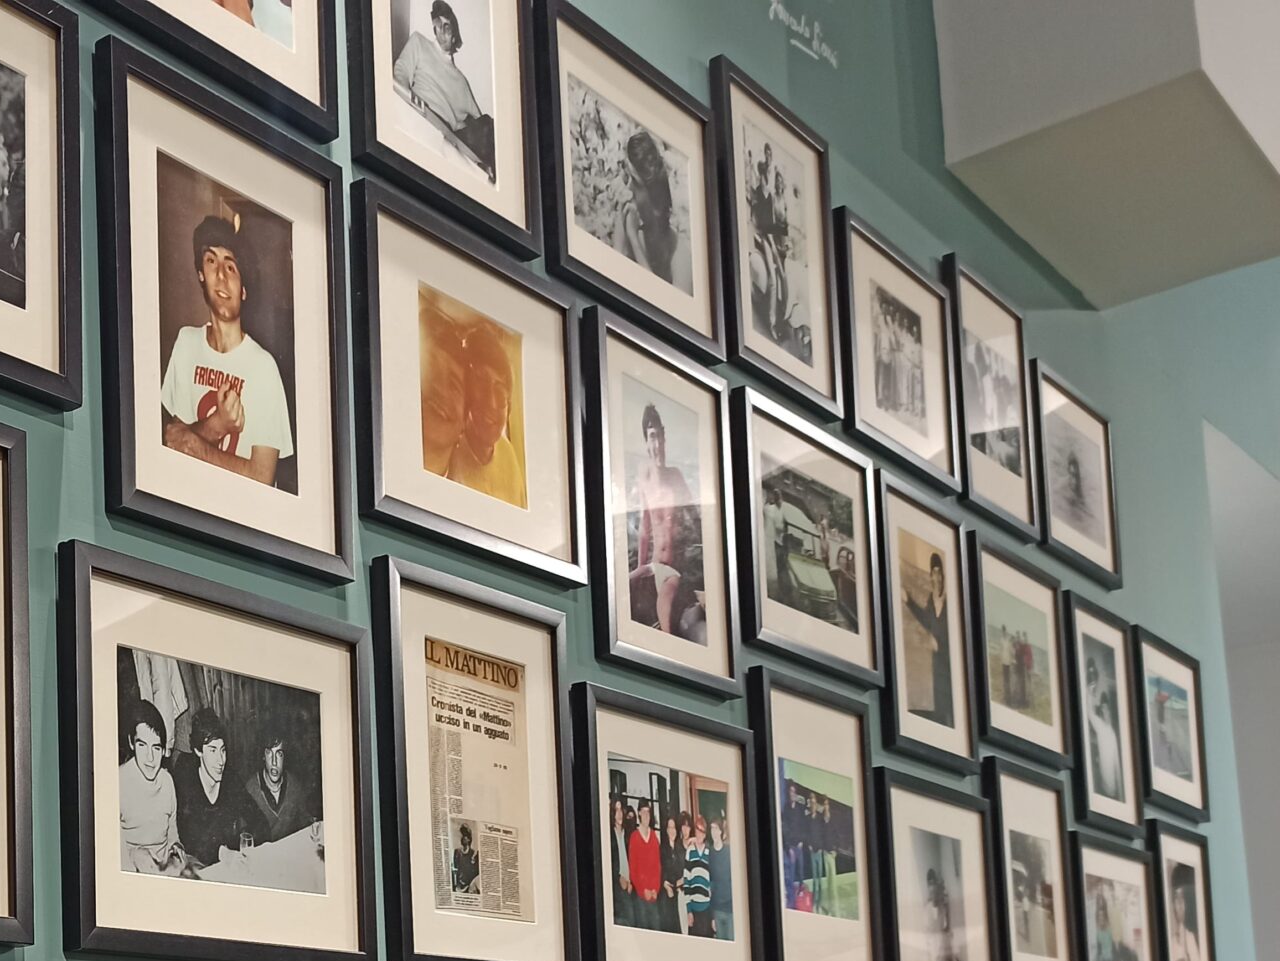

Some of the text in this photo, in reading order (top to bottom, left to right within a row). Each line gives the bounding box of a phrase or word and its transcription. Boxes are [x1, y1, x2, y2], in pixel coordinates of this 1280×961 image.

[425, 639, 519, 688] IL MATTINO
[431, 696, 463, 715] Cronista
[466, 706, 476, 718] del
[435, 713, 460, 728] ucciso
[463, 718, 470, 730] in
[472, 723, 481, 733] un
